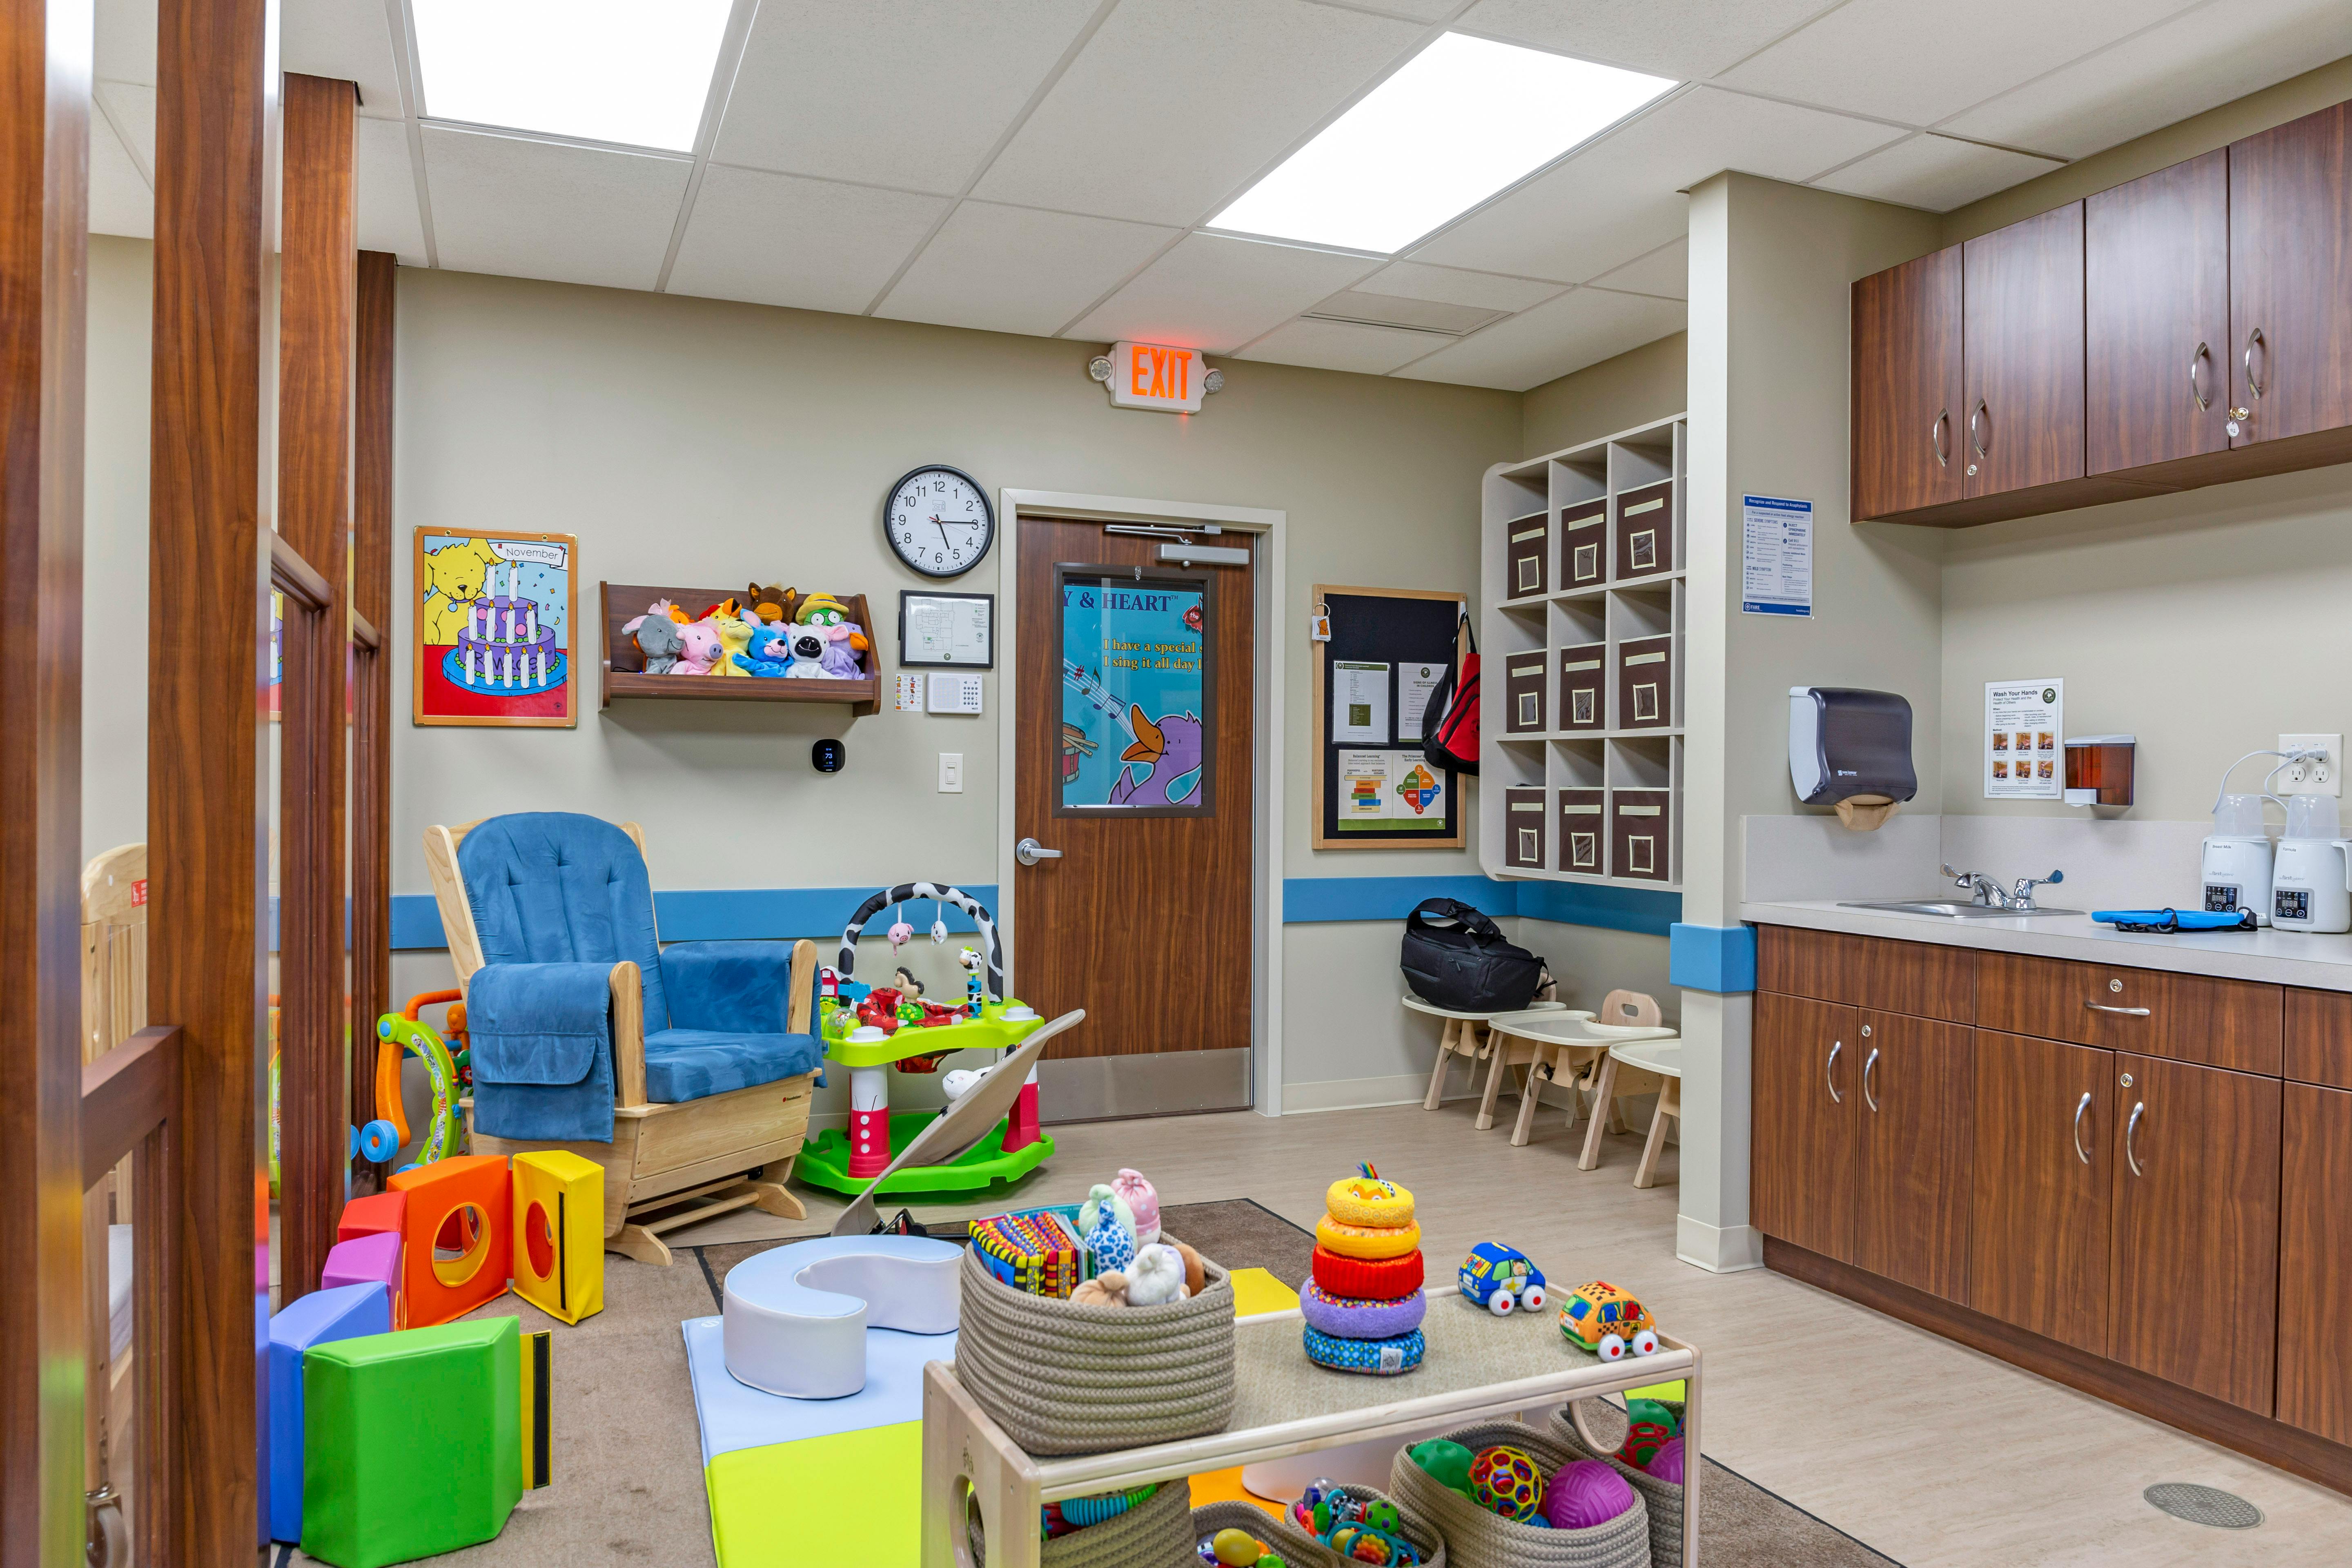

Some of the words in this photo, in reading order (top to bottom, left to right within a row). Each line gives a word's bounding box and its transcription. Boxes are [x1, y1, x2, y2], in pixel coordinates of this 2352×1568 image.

[1131, 346, 1192, 400] EXIT
[916, 486, 926, 497] 11
[933, 481, 945, 492] 12
[953, 488, 958, 499] 1
[904, 496, 916, 507] 10
[966, 501, 973, 511] 2
[899, 514, 906, 526] 9
[971, 519, 979, 530] 3
[904, 533, 911, 543] 8
[966, 537, 973, 547] 4
[506, 548, 558, 560] November
[918, 547, 926, 557] 7
[935, 552, 942, 563] 6
[953, 549, 960, 559] 5
[1080, 591, 1094, 609] &
[1189, 612, 1199, 620] the
[1103, 639, 1109, 650] I
[1112, 639, 1140, 651] have
[1144, 642, 1151, 652] a
[1155, 642, 1195, 654] special
[1103, 656, 1109, 667] I
[1112, 656, 1138, 670] sing
[1142, 657, 1151, 668] it
[1155, 657, 1169, 669] all
[1174, 658, 1194, 672] day
